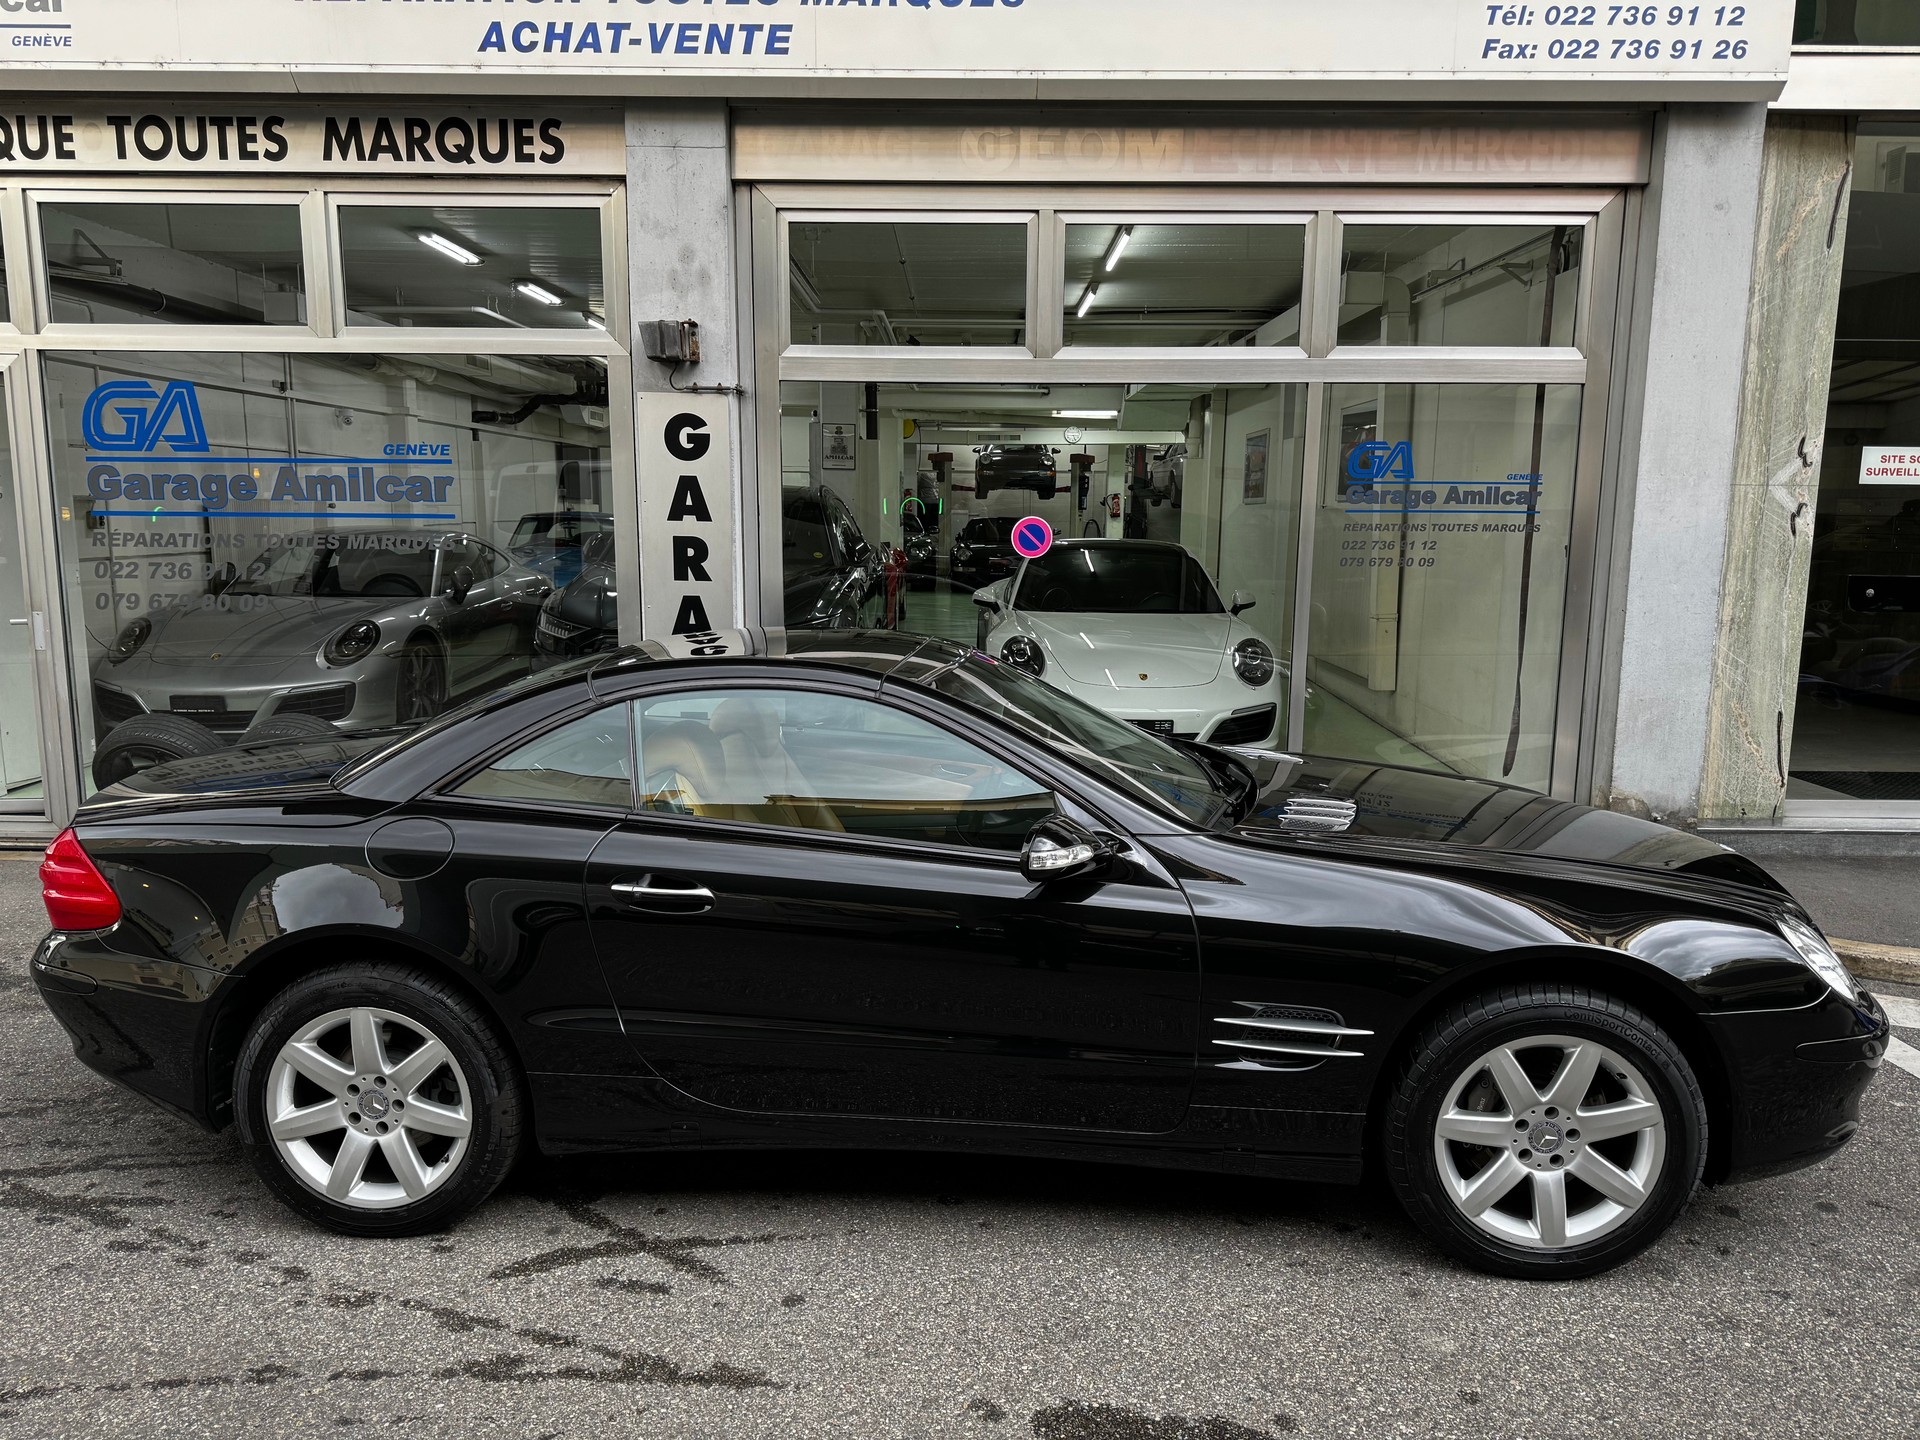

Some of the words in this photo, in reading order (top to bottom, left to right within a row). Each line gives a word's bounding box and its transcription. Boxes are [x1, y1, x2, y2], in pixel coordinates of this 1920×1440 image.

[1486, 5, 1534, 26] Tél:
[1544, 6, 1597, 26] 022
[1607, 6, 1658, 26] 736
[1667, 6, 1700, 26] 91
[1714, 6, 1746, 26] 12
[12, 33, 72, 46] GENÈVE
[477, 21, 793, 55] ACHAT-VENTE
[1482, 39, 1538, 59] Fax:
[1548, 39, 1600, 59] 022
[1610, 39, 1661, 59] 736
[1669, 39, 1702, 59] 91
[1712, 39, 1749, 59] 26
[107, 115, 288, 161] TOUTES
[323, 117, 565, 164] MARQUES
[383, 442, 450, 456] GENÈVE
[1880, 455, 1905, 463] SITE
[87, 464, 258, 510] Garage
[271, 466, 454, 503] Amilcar
[1345, 485, 1437, 509] Garage
[1443, 486, 1543, 505] Amilcar
[1343, 521, 1427, 533] RÉPARATIONS
[1431, 523, 1478, 533] TOUTES
[1481, 523, 1541, 533] MARQUES
[92, 529, 245, 549] RÉPARATIONS
[254, 534, 340, 550] TOUTES
[347, 534, 455, 550] MARQUES
[1342, 540, 1366, 551] 022
[1371, 540, 1396, 551] 736
[1400, 540, 1416, 551] 91
[1421, 541, 1437, 551] 12
[94, 561, 139, 580] 022
[148, 562, 193, 580] 736
[201, 562, 229, 581] 91
[241, 562, 266, 581] 12
[1340, 557, 1364, 568] 079
[1369, 557, 1393, 568] 679
[1418, 557, 1435, 568] 09
[96, 592, 141, 611] 079
[149, 592, 192, 611] 679
[202, 593, 231, 612] 80
[240, 593, 269, 612] 09
[1564, 1008, 1662, 1061] ContiSportContact
